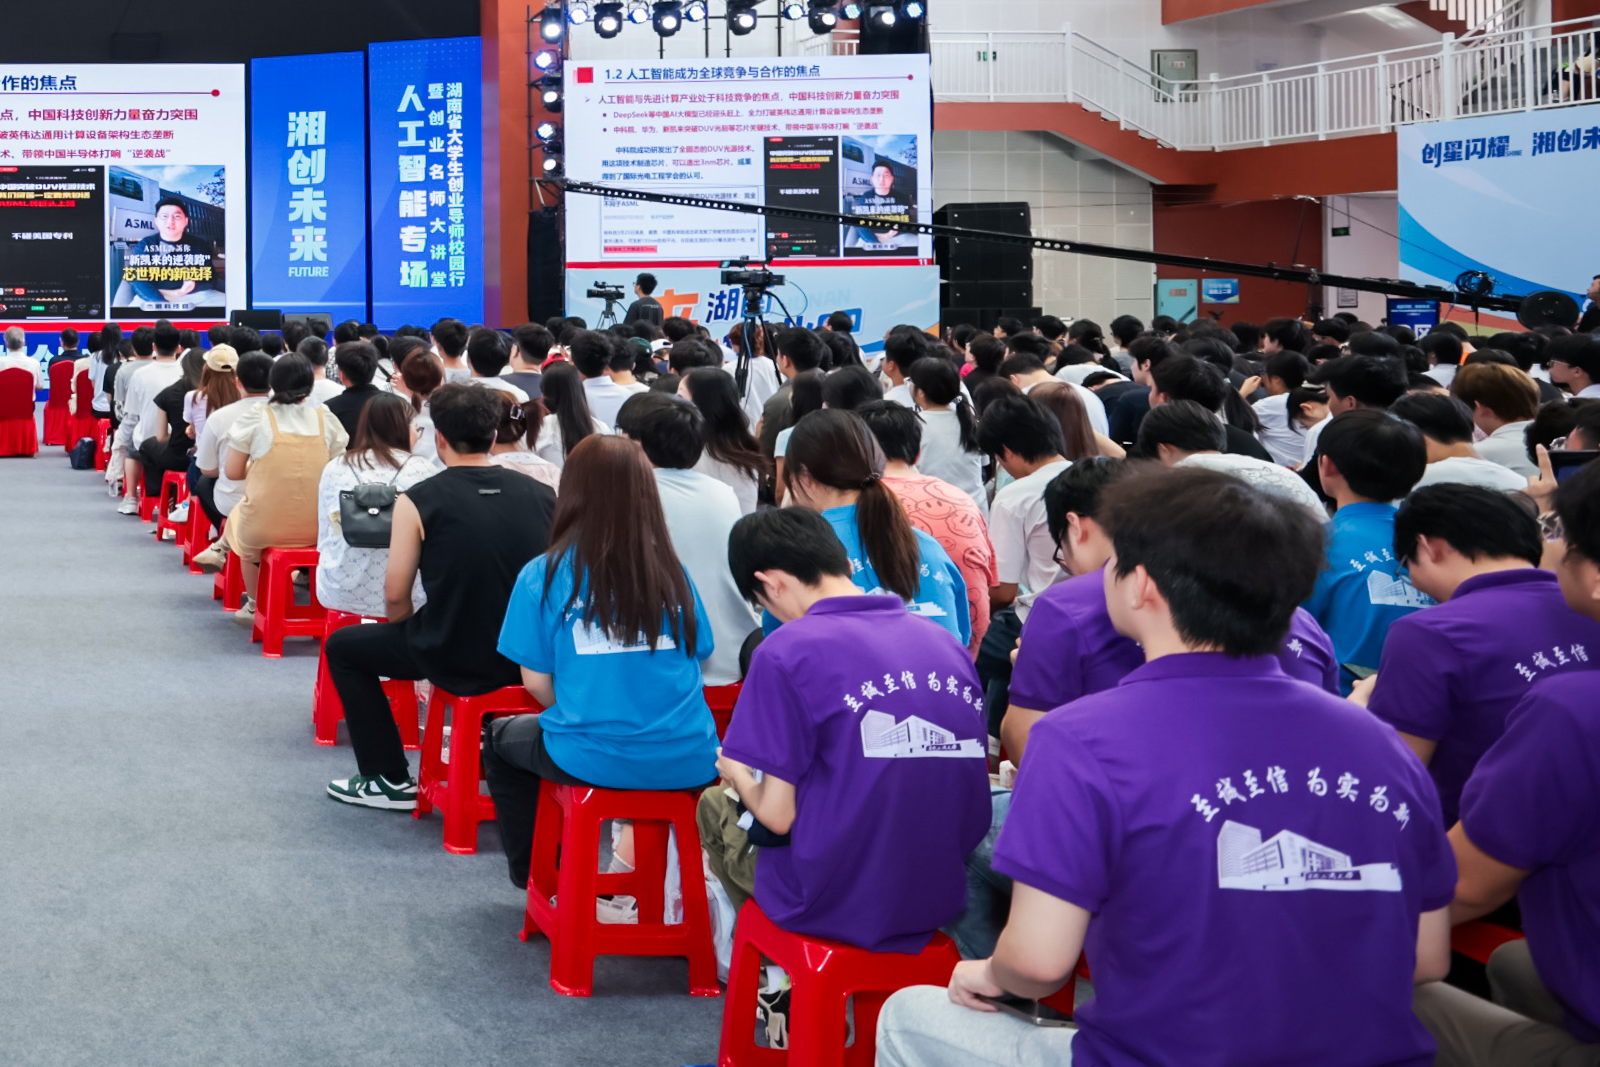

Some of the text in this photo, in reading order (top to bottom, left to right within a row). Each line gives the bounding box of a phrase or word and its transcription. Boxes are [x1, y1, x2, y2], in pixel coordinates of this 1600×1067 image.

[605, 65, 821, 80] 1.2 人工智能成为全球竞争与合作的焦点
[1422, 135, 1510, 168] 创星闪耀
[287, 110, 328, 262] 湘创未来
[397, 84, 428, 288] 人工智能专场
[428, 82, 447, 288] 暨创业名师大讲堂
[446, 82, 465, 288] 湖南省大学生创业导师校园行
[125, 218, 155, 231] ASML
[122, 266, 213, 282] 芯世界的新选择
[288, 266, 329, 277] FUTURE
[1191, 765, 1289, 823] 至诚至信
